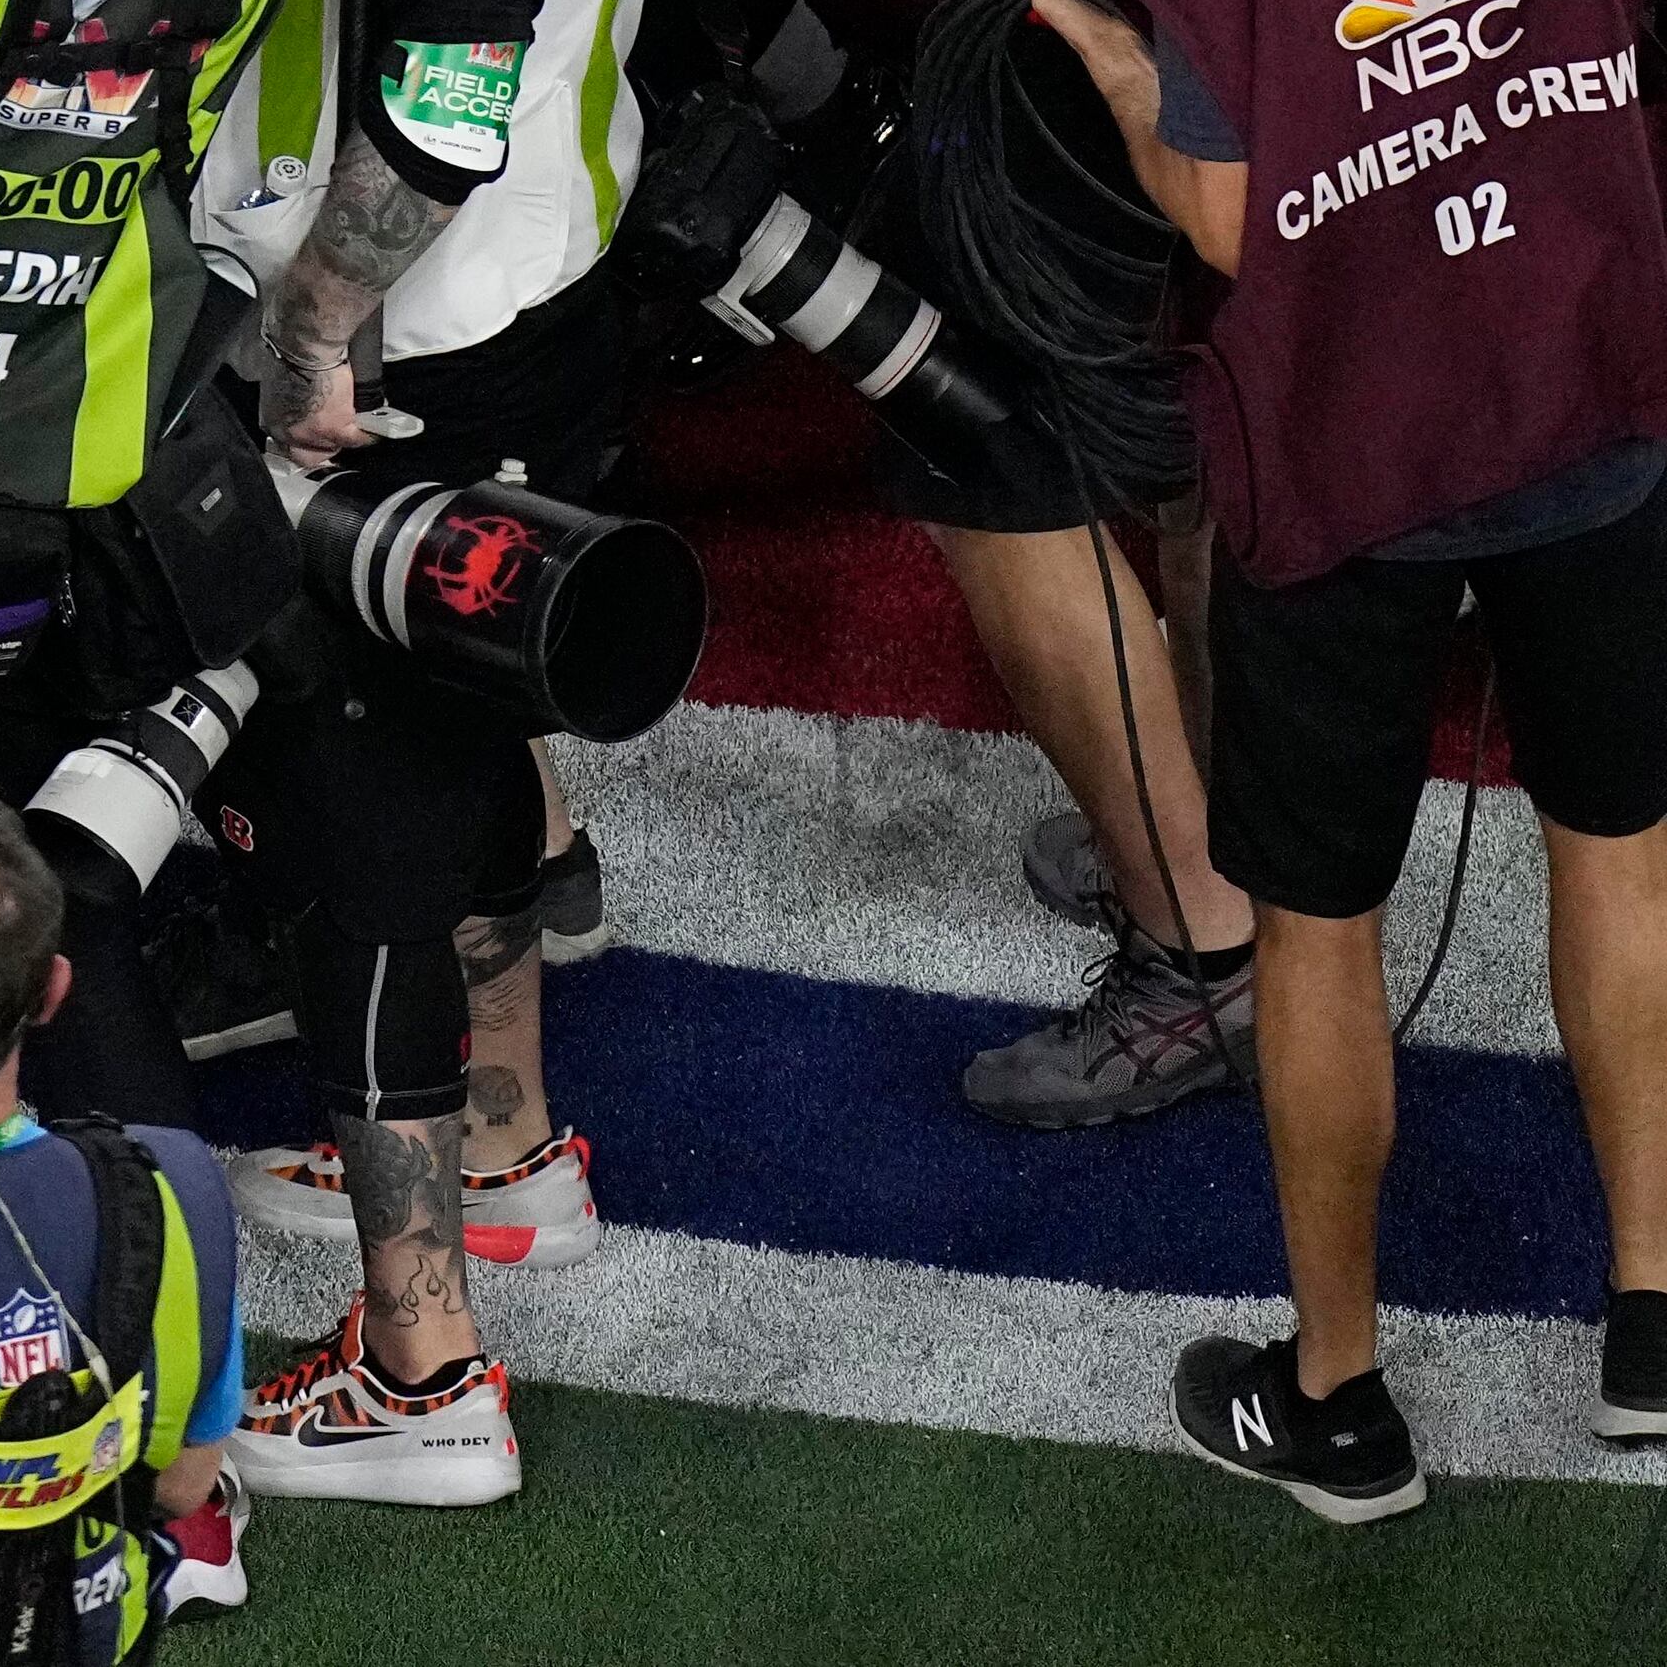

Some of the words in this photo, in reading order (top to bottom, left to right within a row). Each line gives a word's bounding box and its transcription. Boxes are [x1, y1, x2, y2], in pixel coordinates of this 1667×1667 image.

[423, 64, 513, 100] FIELD
[0, 102, 91, 132] SUPER
[1275, 100, 1488, 242] CAMERA
[1494, 41, 1640, 130] CREW
[1433, 180, 1516, 257] 02
[421, 1437, 457, 1448] WHO
[460, 1436, 492, 1447] DEY
[1231, 1393, 1275, 1452] N
